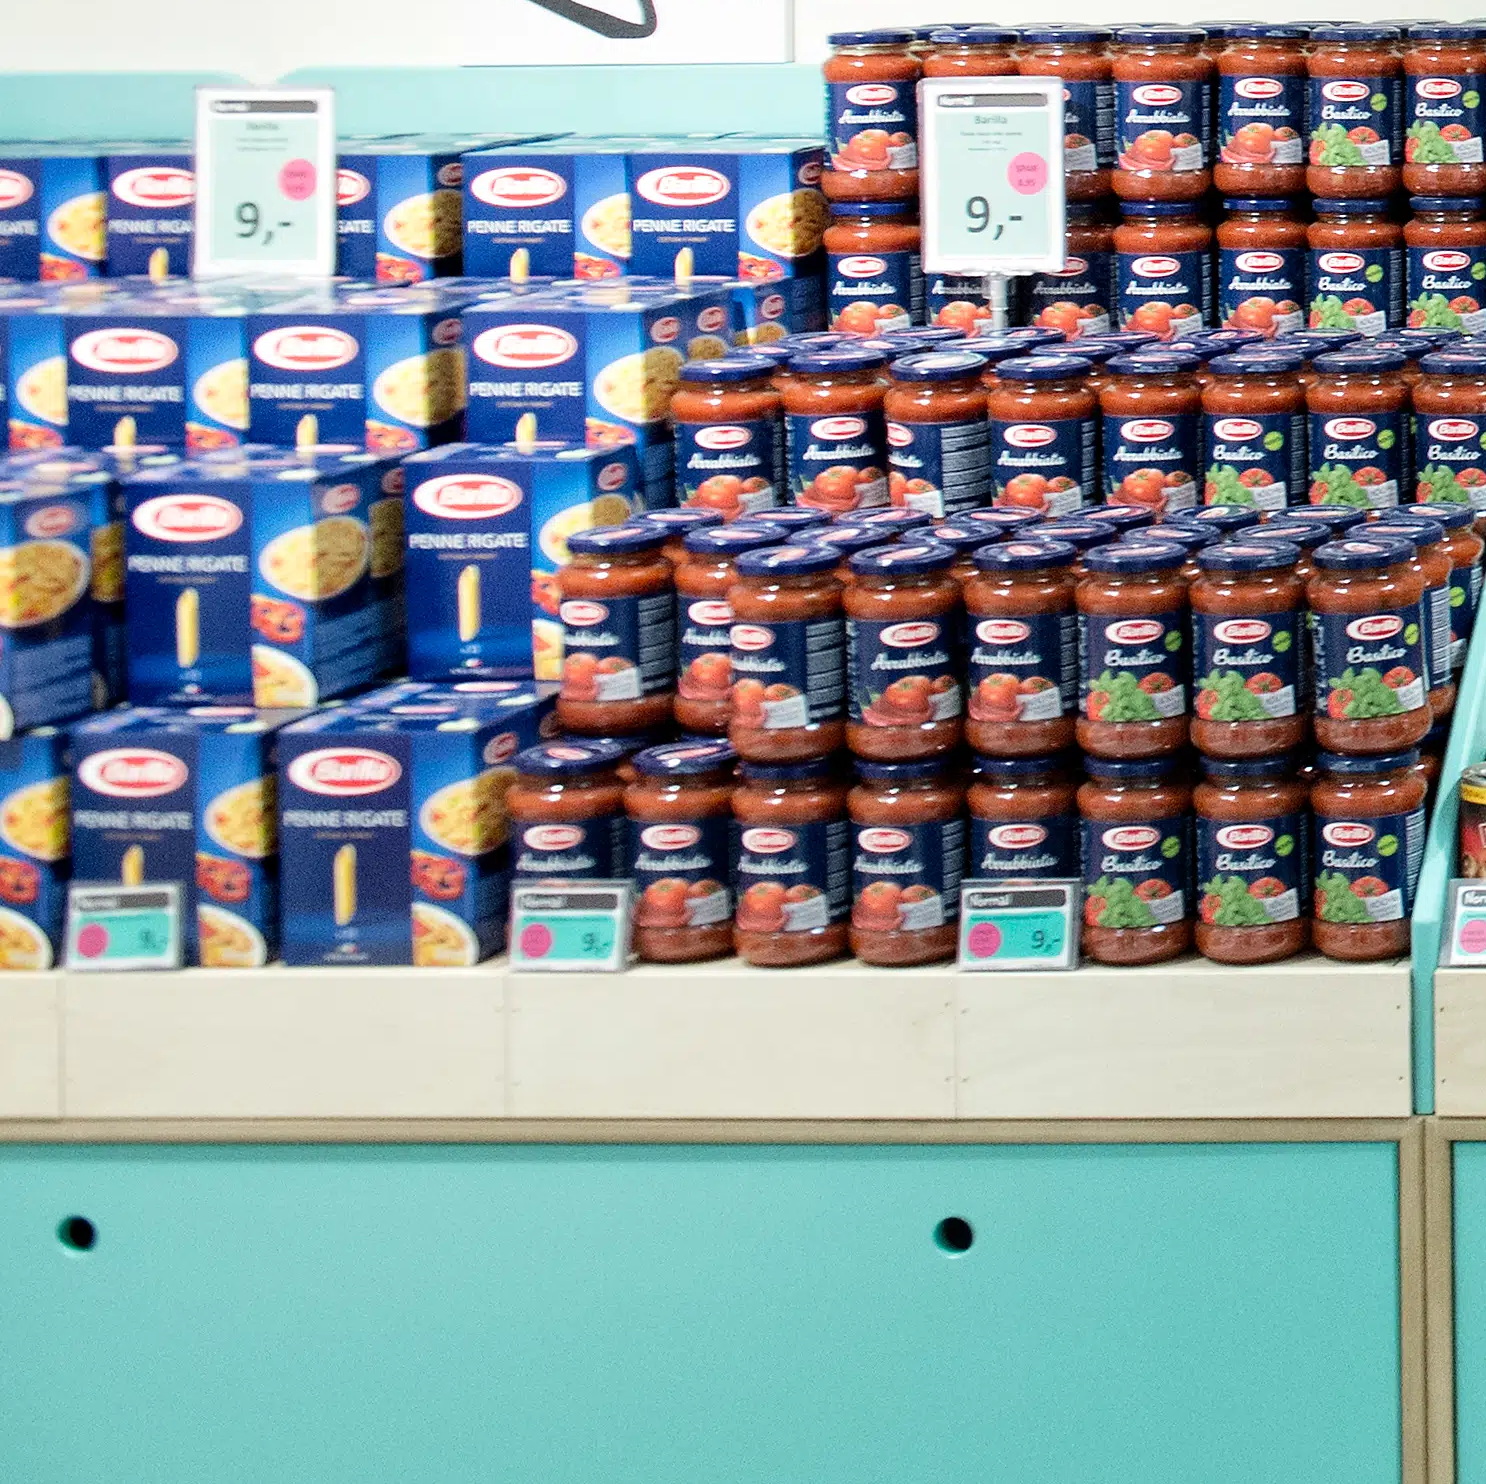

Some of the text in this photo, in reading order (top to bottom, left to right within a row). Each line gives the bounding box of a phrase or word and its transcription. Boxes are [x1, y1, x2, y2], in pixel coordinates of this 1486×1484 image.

[235, 201, 294, 246] 9,-
[633, 219, 735, 233] PENNE RIGATE
[965, 195, 1023, 241] 9,-
[468, 219, 573, 234] PENNE RIGATE
[469, 381, 583, 397] PENNE RIGATE
[409, 532, 529, 549] PENNE RIGATE
